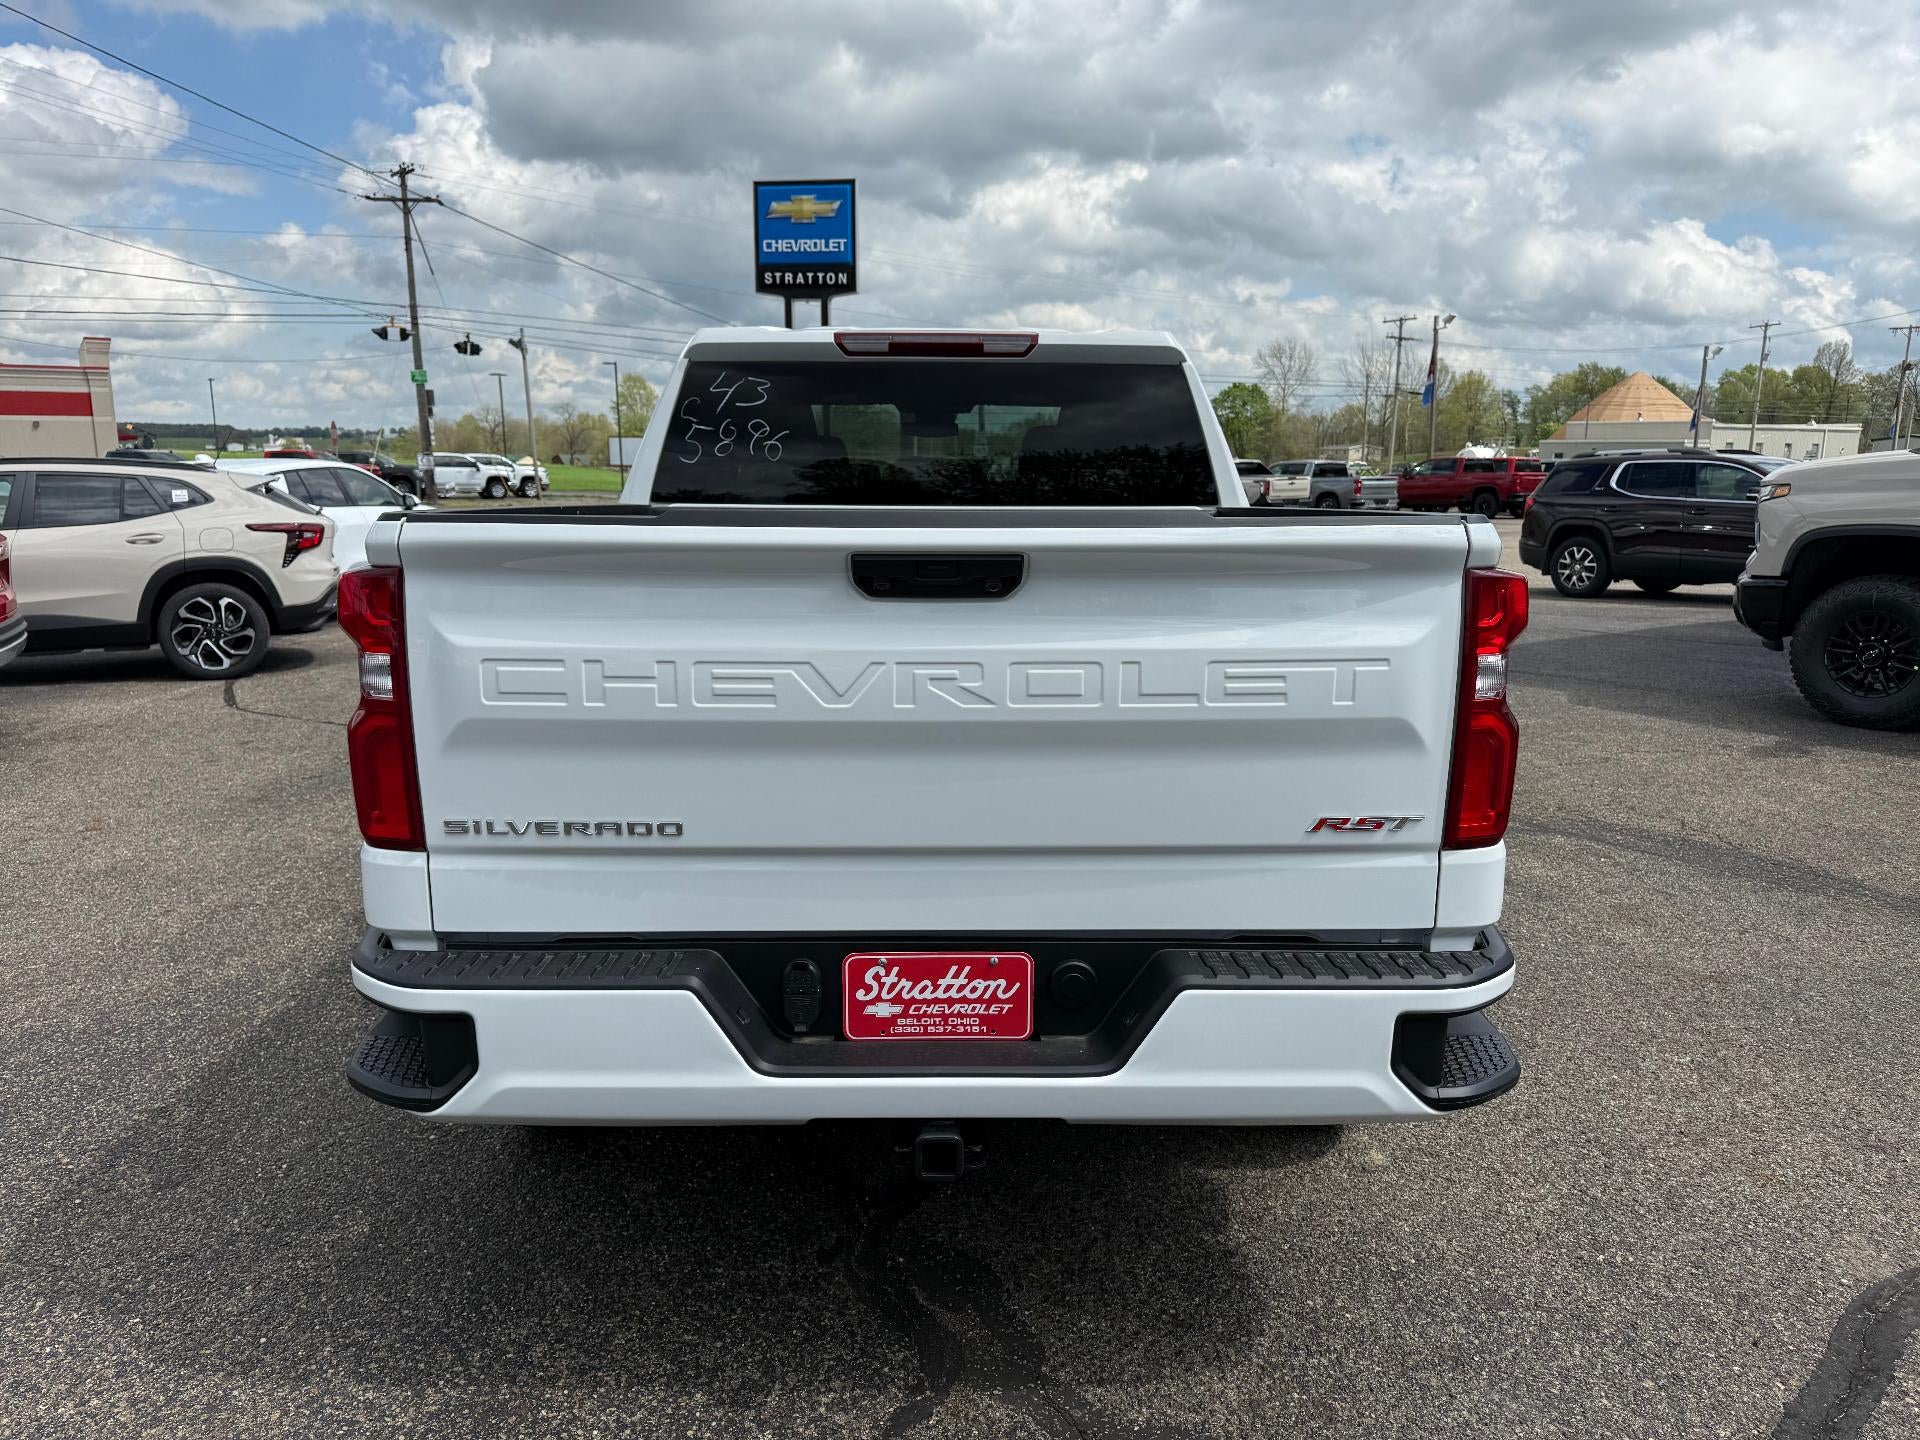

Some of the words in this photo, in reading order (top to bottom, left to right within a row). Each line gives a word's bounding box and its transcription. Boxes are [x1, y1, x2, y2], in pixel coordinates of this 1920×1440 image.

[763, 239, 847, 252] CHEVROLET
[764, 272, 847, 285] STRATTON
[710, 371, 770, 414] 43
[679, 418, 790, 463] 5896
[480, 658, 1391, 709] CHEVROLET
[443, 818, 683, 836] SILVERADO
[1305, 815, 1426, 832] RST
[855, 965, 1021, 1001] Stratton
[908, 1003, 1013, 1015] CHEVROLET
[890, 1026, 924, 1034] (330)
[897, 1017, 944, 1026] BELOIT,
[948, 1017, 980, 1025] OHIO
